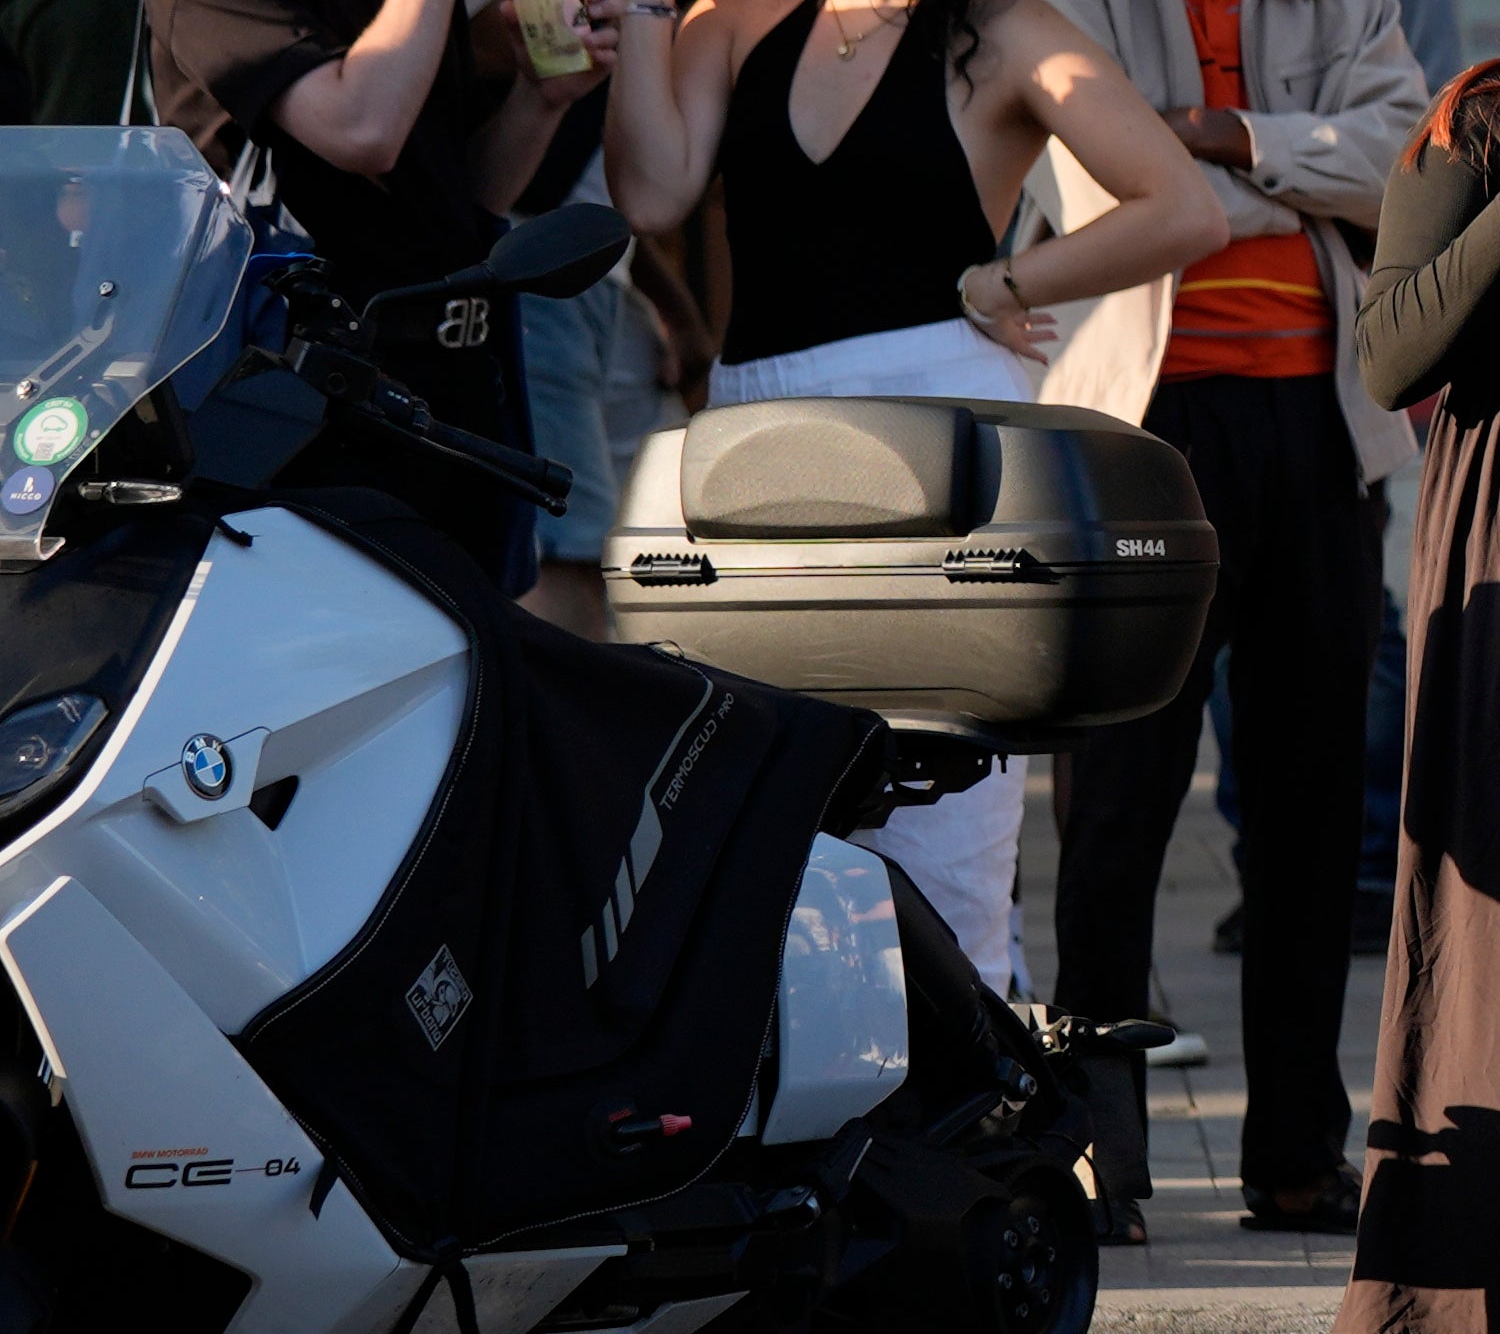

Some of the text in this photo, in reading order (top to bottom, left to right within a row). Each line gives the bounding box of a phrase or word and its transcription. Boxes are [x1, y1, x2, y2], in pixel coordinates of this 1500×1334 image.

[1116, 539, 1166, 557] SH44
[717, 692, 735, 720] PRO
[185, 736, 223, 763] BMW
[125, 1158, 234, 1190] CE
